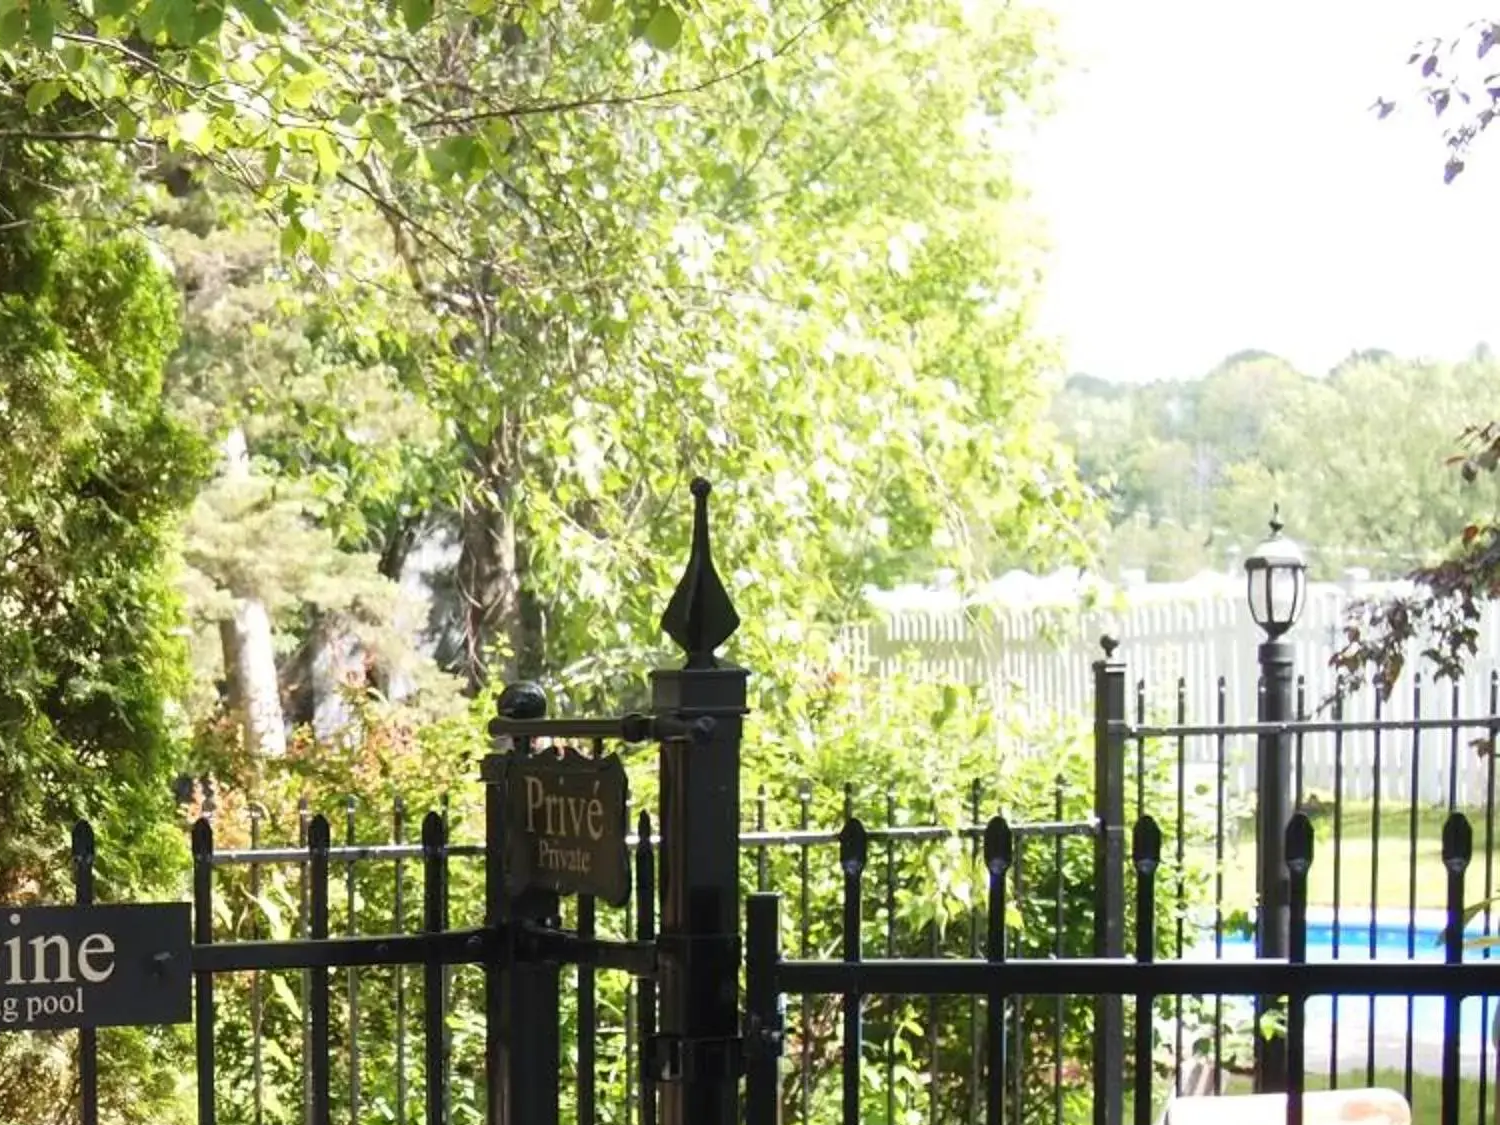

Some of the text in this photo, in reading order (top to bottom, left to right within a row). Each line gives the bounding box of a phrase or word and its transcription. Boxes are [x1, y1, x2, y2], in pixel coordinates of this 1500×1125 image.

[524, 775, 604, 841] Privé
[537, 839, 591, 873] Private
[27, 987, 85, 1024] pool
